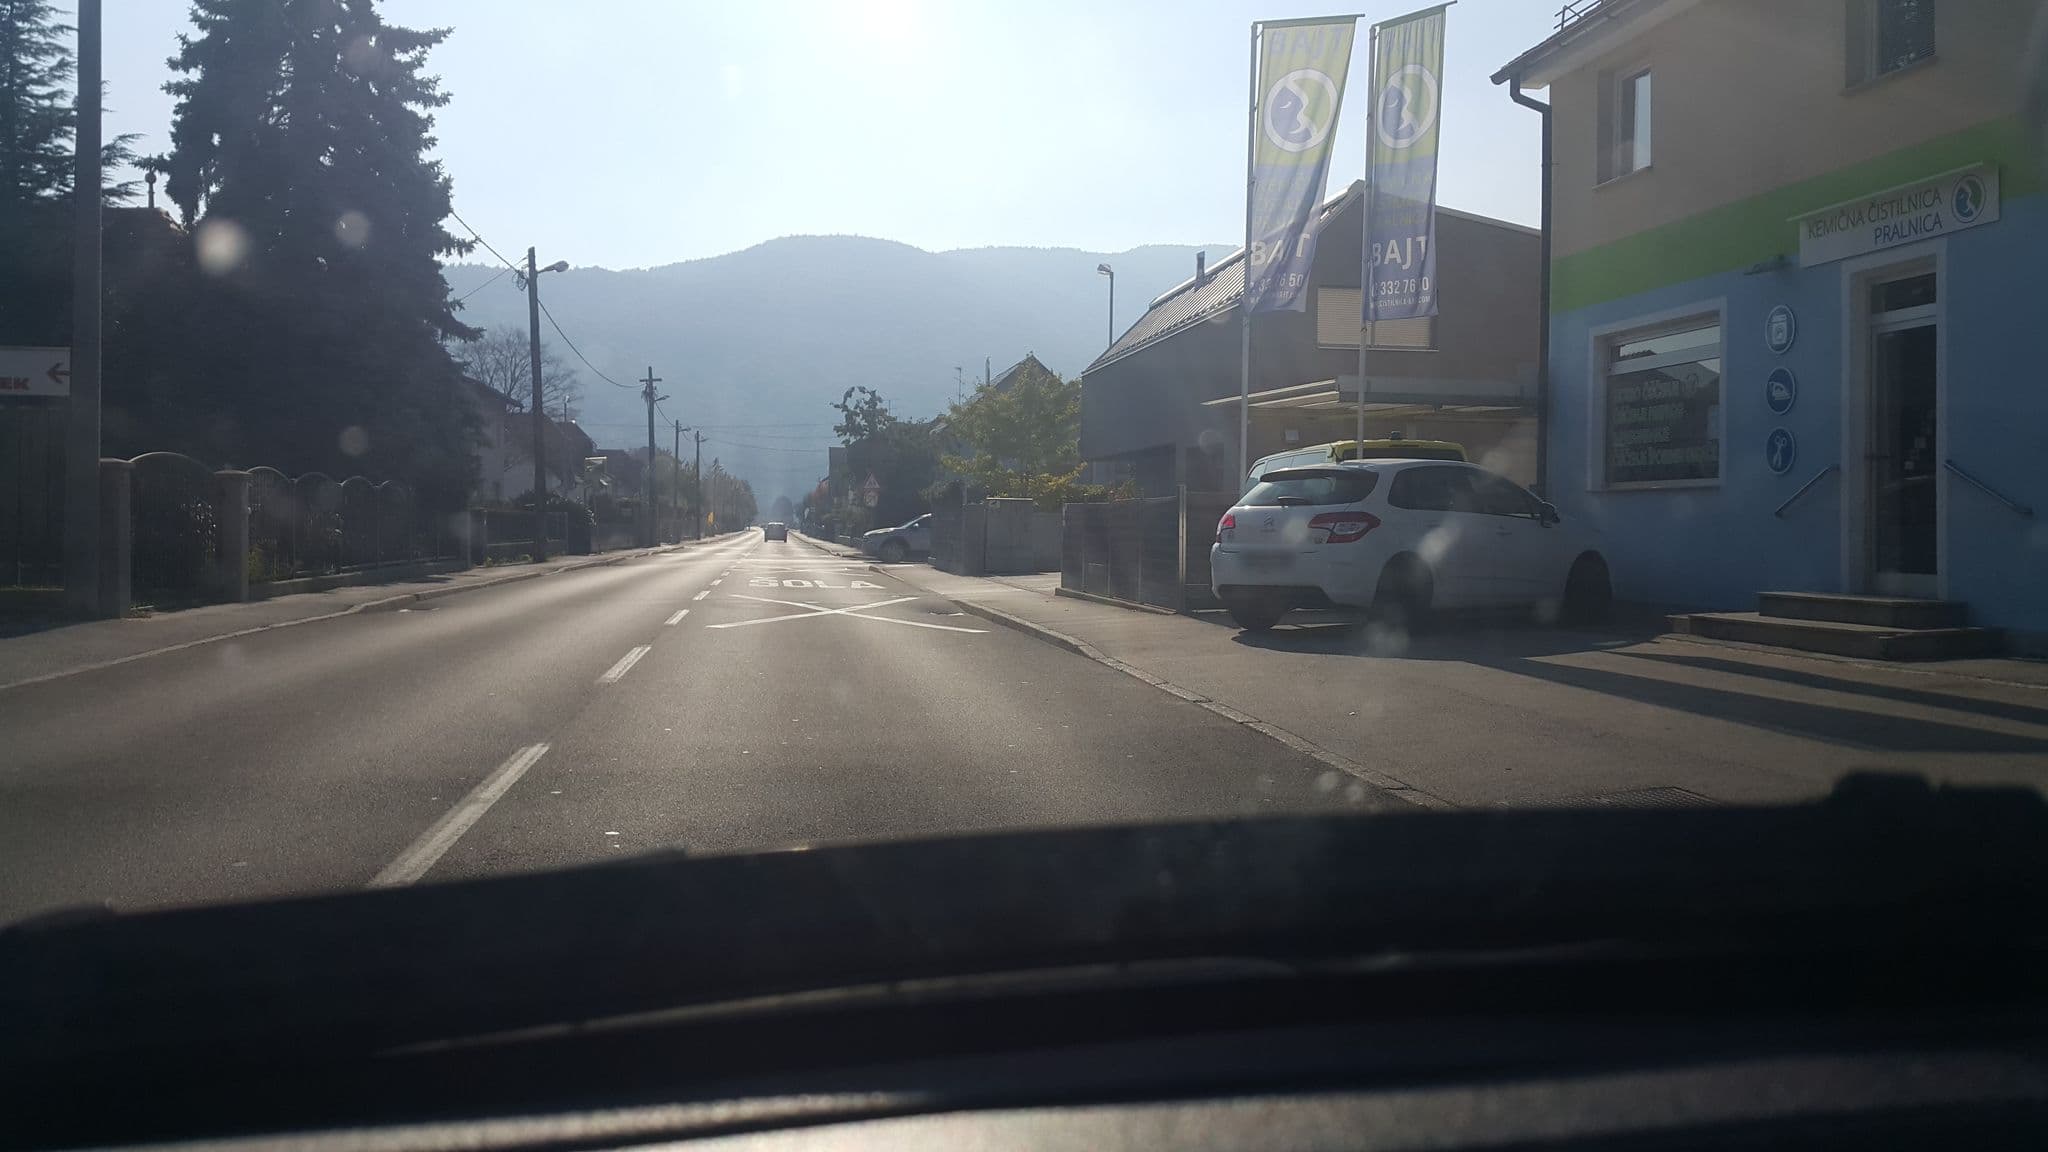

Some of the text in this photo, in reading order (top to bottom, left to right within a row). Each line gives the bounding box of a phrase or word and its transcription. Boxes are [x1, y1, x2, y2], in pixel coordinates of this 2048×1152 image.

[1808, 187, 1943, 239] KEMIČNA ČISTILNICA
[1874, 212, 1943, 247] PRALNICA
[1372, 235, 1427, 270] BAJT
[1380, 280, 1401, 295] 332
[1403, 279, 1416, 293] 76
